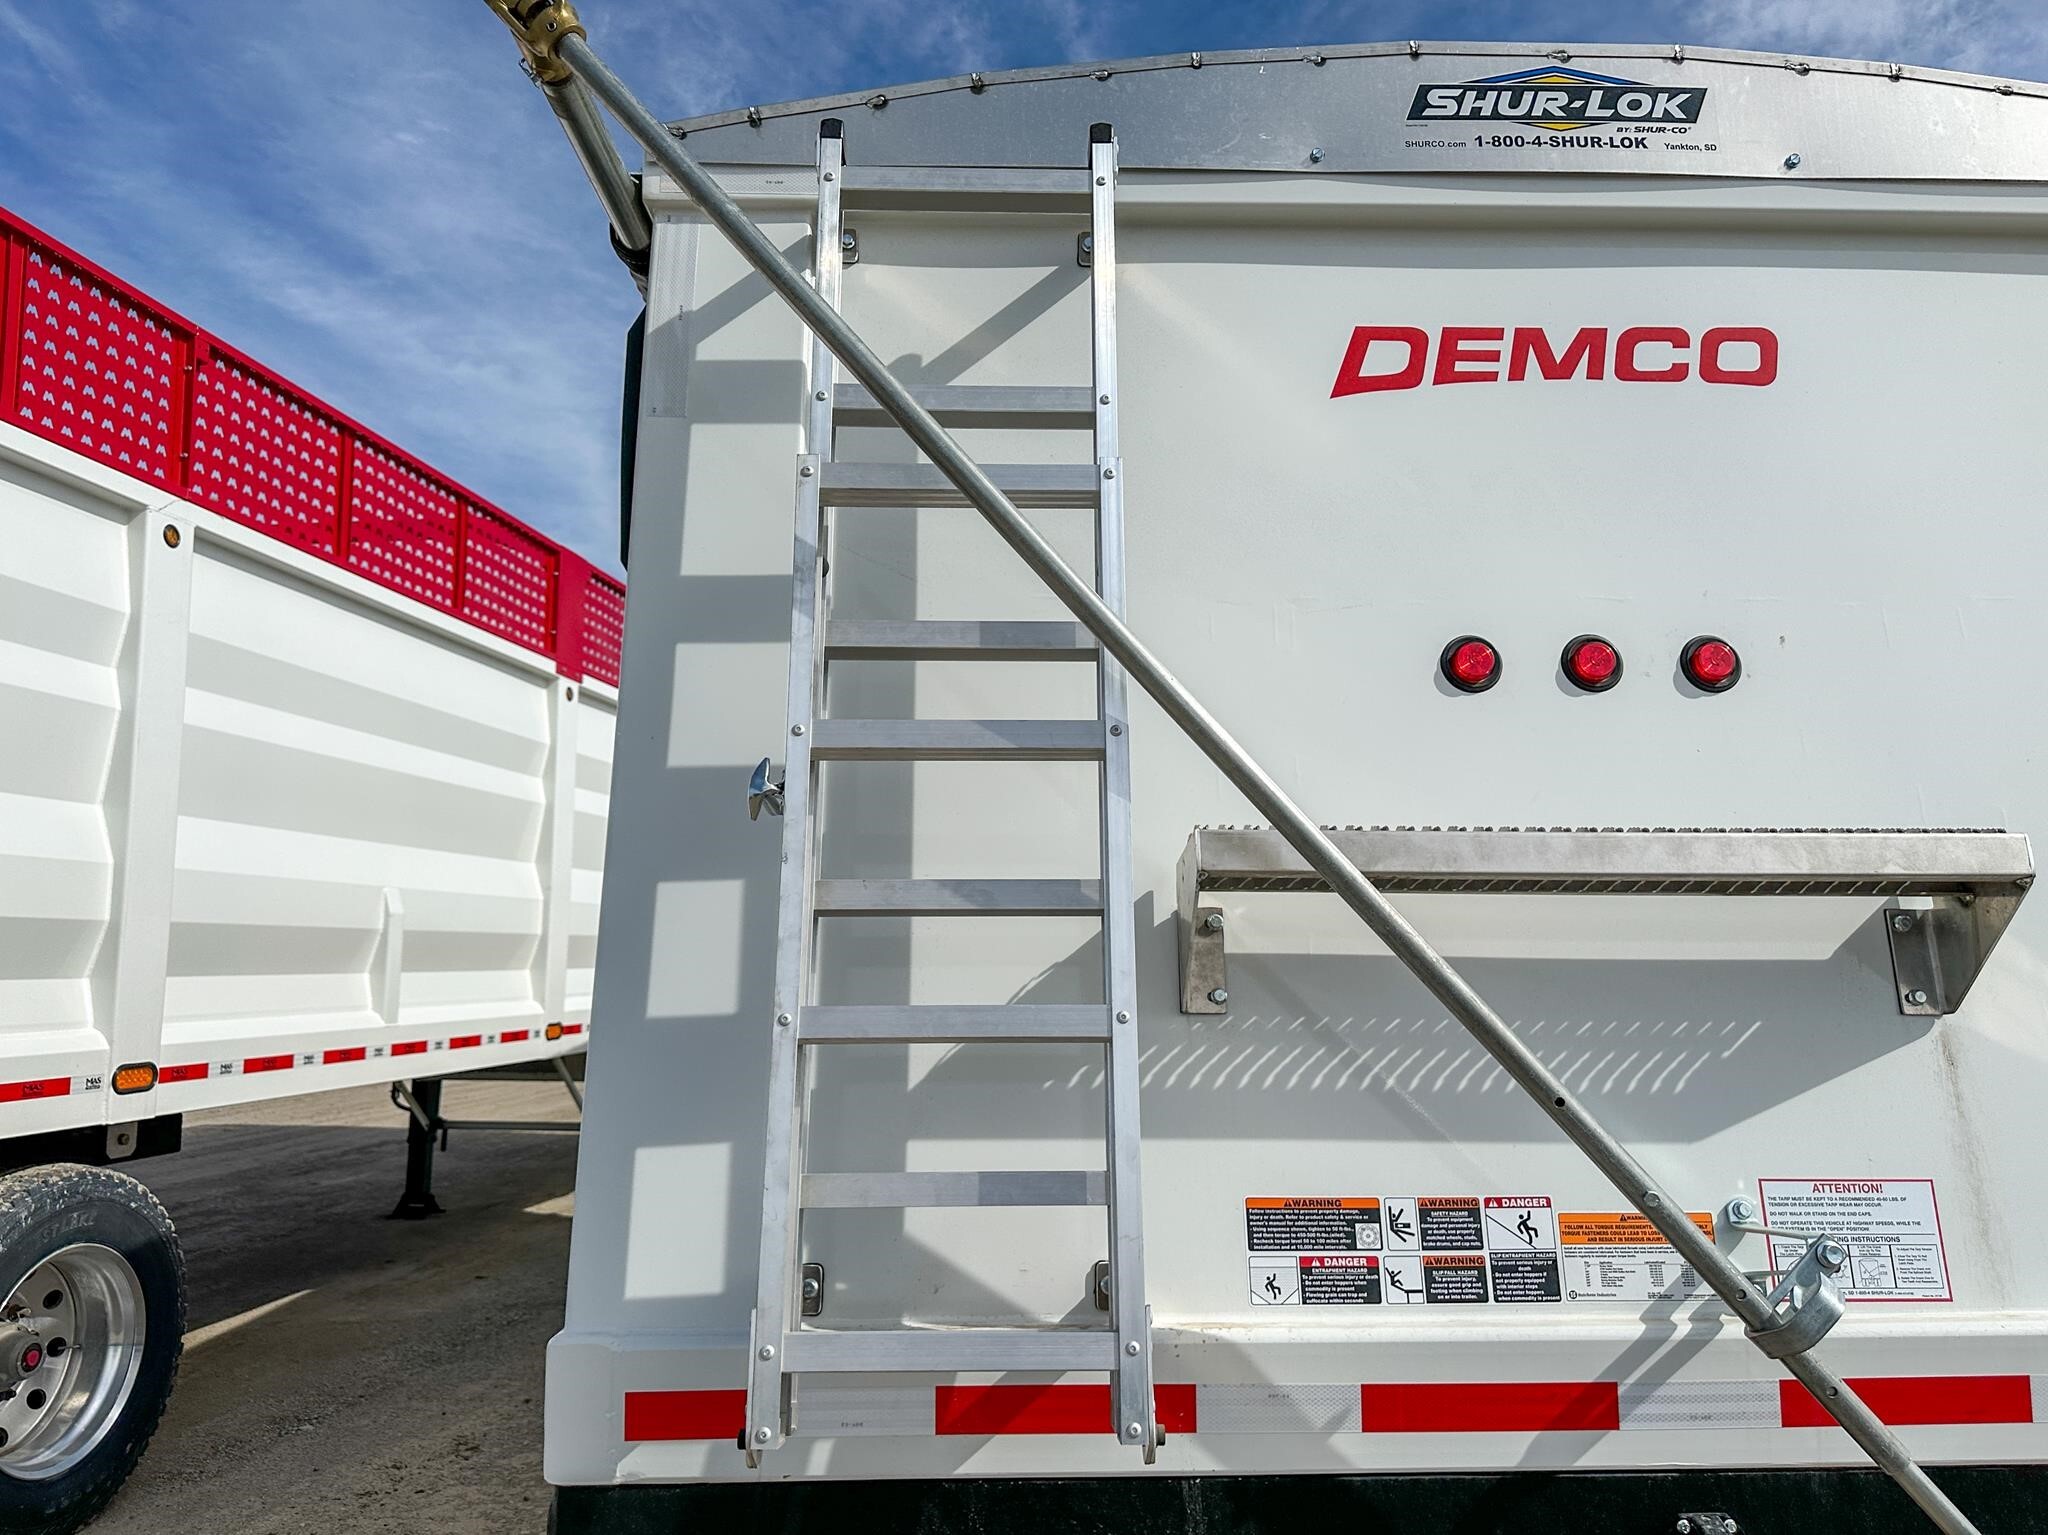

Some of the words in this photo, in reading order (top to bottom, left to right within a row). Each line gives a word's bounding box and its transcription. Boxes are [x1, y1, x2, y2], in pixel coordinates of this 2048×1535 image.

[1422, 88, 1692, 119] SHUR-LOK
[1474, 135, 1648, 149] 1-800-4-SHUR-LOK
[1664, 143, 1702, 151] Yankton,
[1330, 326, 1778, 399] DEMCO
[86, 1076, 102, 1085] MAS
[1812, 1184, 1882, 1194] ATTENTION!
[1292, 1200, 1342, 1208] WARNING
[1502, 1198, 1547, 1207] DANGER
[1324, 1258, 1367, 1266] DANGER
